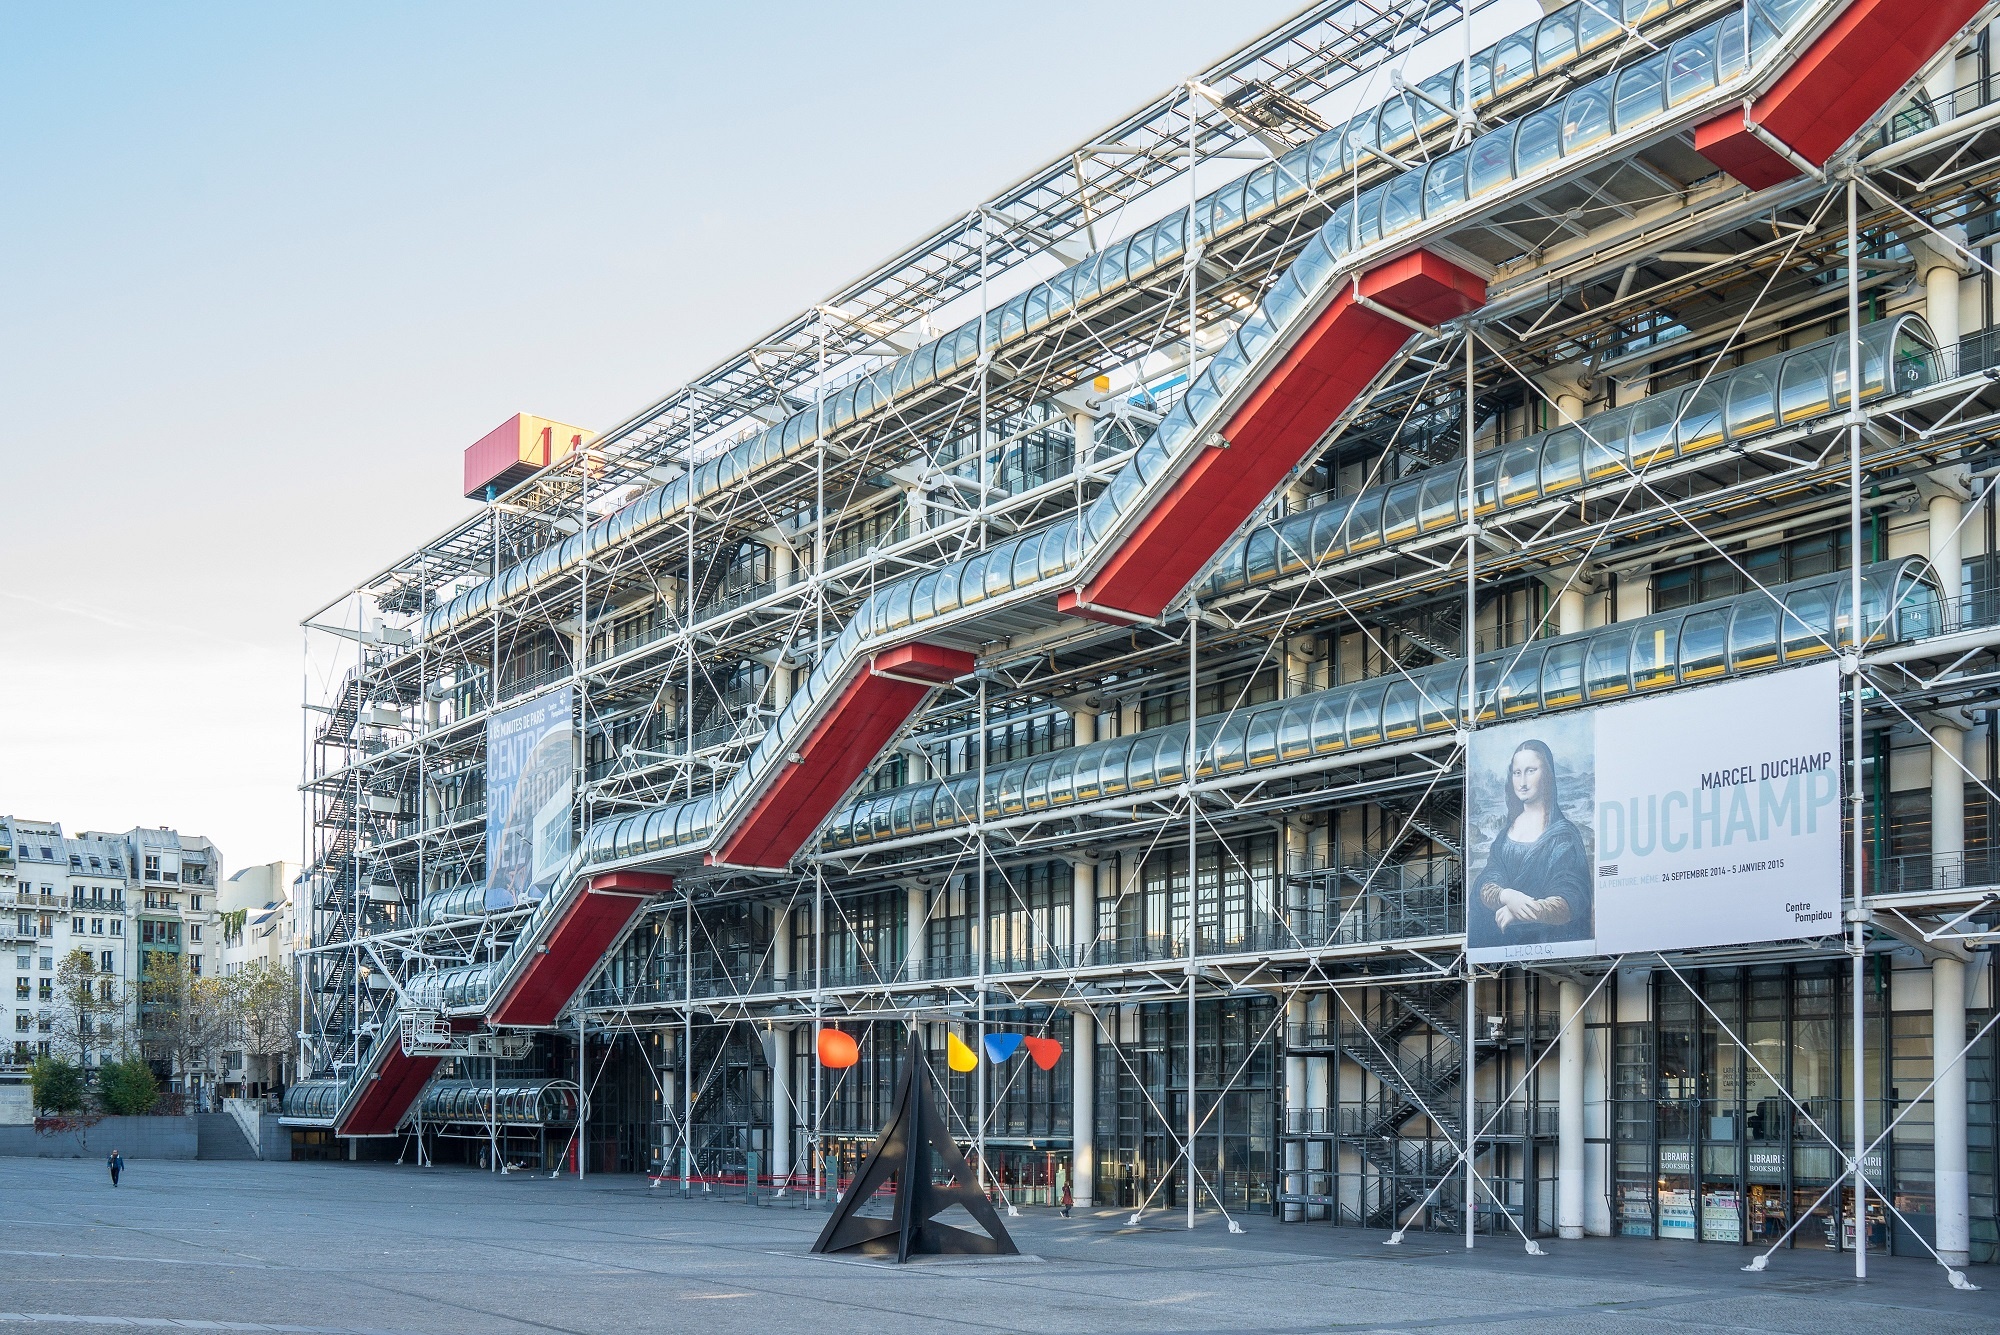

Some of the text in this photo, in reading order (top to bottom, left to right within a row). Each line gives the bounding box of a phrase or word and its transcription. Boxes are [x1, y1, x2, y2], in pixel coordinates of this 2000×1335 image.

[501, 717, 523, 737] MINUTES
[523, 714, 530, 729] DE
[531, 709, 545, 727] PARIS
[489, 726, 545, 782] CENTRE
[1701, 752, 1832, 790] MARCEL DUCHAMP
[489, 765, 567, 826] POMPIDOU
[1599, 767, 1838, 861] DUCHAMP
[488, 824, 526, 871] METZ
[1662, 873, 1670, 882] 24
[1671, 868, 1708, 881] SEPTEMBRE
[1710, 866, 1726, 877] 2014
[1732, 865, 1737, 874] 5
[1738, 861, 1766, 873] JANVIER
[1768, 859, 1784, 870] 2015
[1785, 902, 1811, 912] Centre
[1795, 910, 1832, 923] Pompidou
